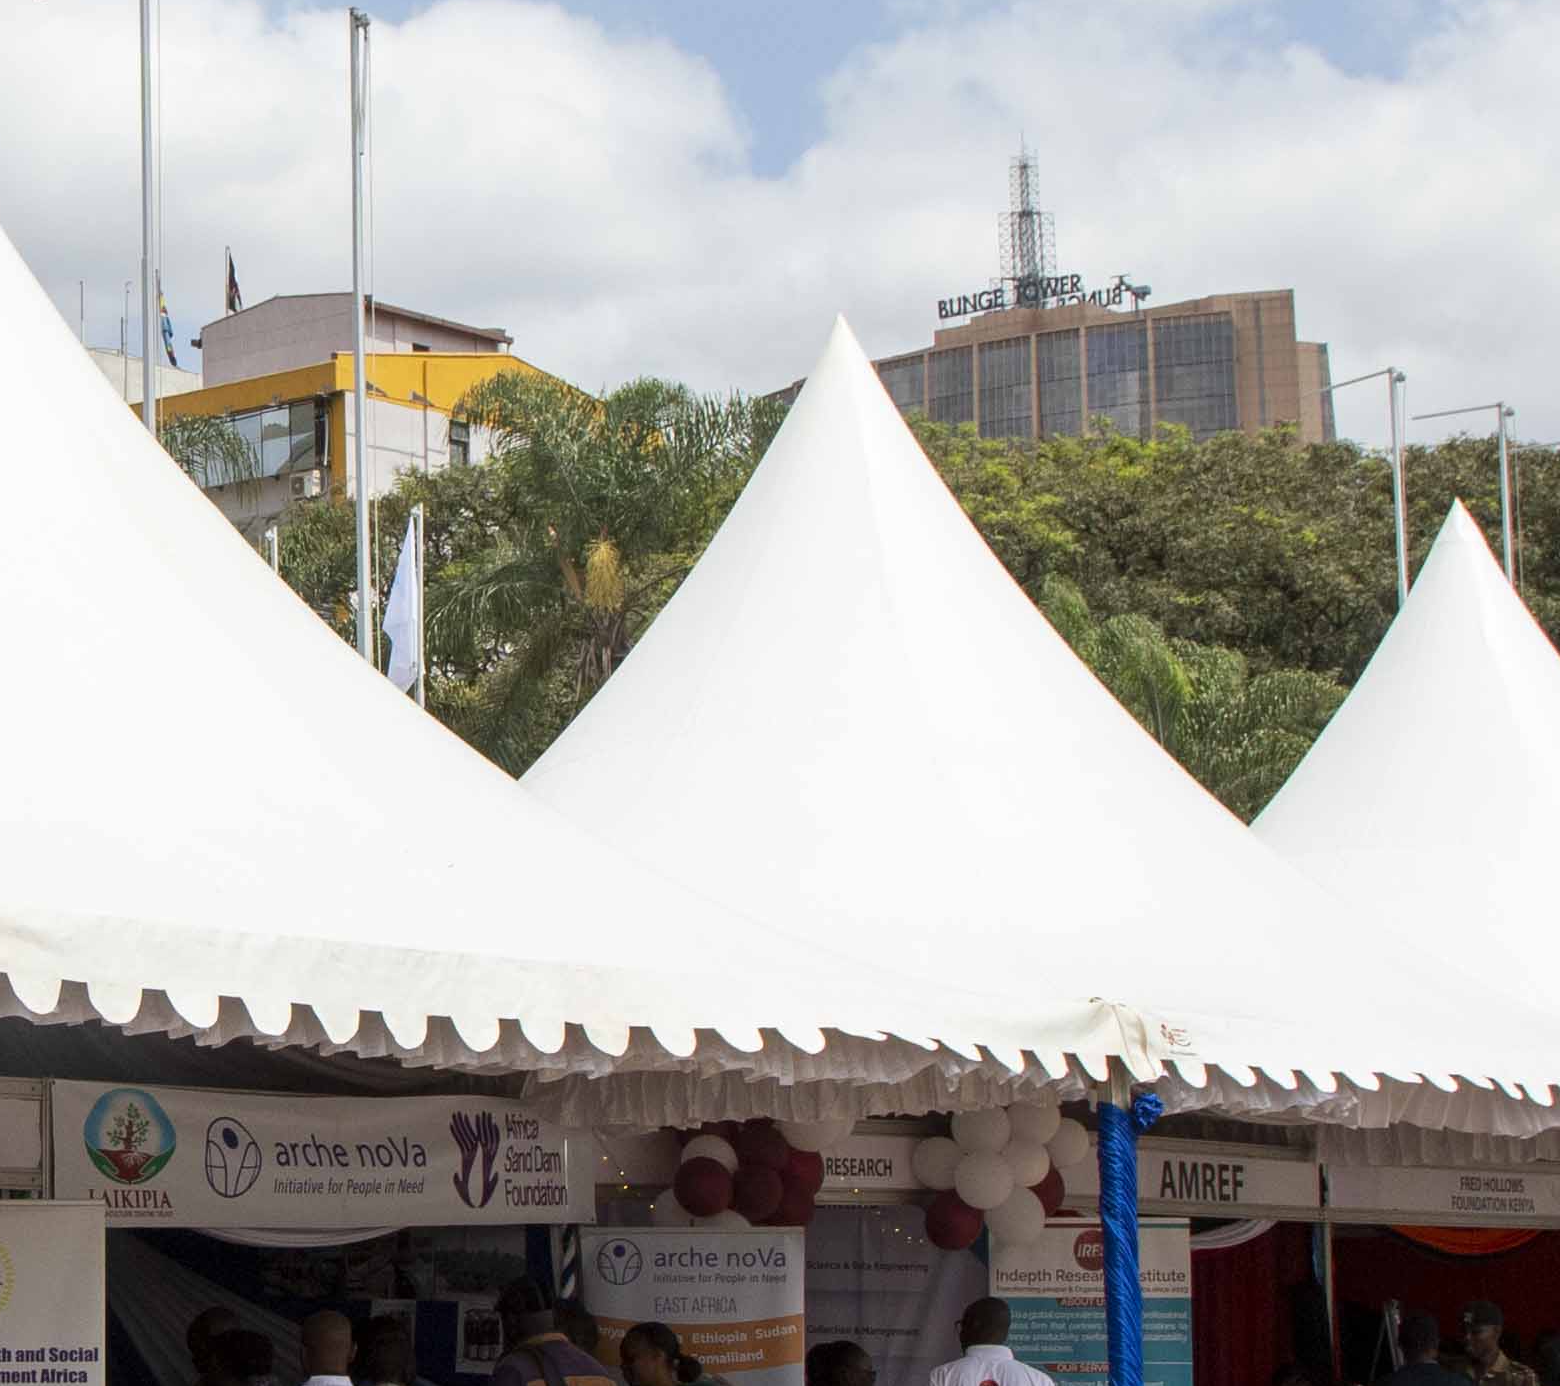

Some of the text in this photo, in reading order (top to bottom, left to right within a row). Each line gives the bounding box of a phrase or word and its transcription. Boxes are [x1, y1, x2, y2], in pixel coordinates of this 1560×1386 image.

[938, 273, 1082, 320] BUNGE TOWER
[506, 1114, 539, 1138] Africa
[275, 1134, 427, 1168] arche noVa
[505, 1145, 562, 1173] Sand Dam
[826, 1158, 892, 1177] RESEARCH
[274, 1177, 424, 1198] Initiative for People in Need
[1161, 1160, 1243, 1201] AMREF
[1460, 1176, 1524, 1192] FRED HOLLOWS
[505, 1179, 567, 1207] Foundation
[1452, 1194, 1535, 1213] FOUNDATION KENYA
[996, 1269, 1052, 1285] Indepth
[15, 1347, 46, 1362] and
[49, 1347, 99, 1362] Social
[41, 1369, 88, 1383] Africa
